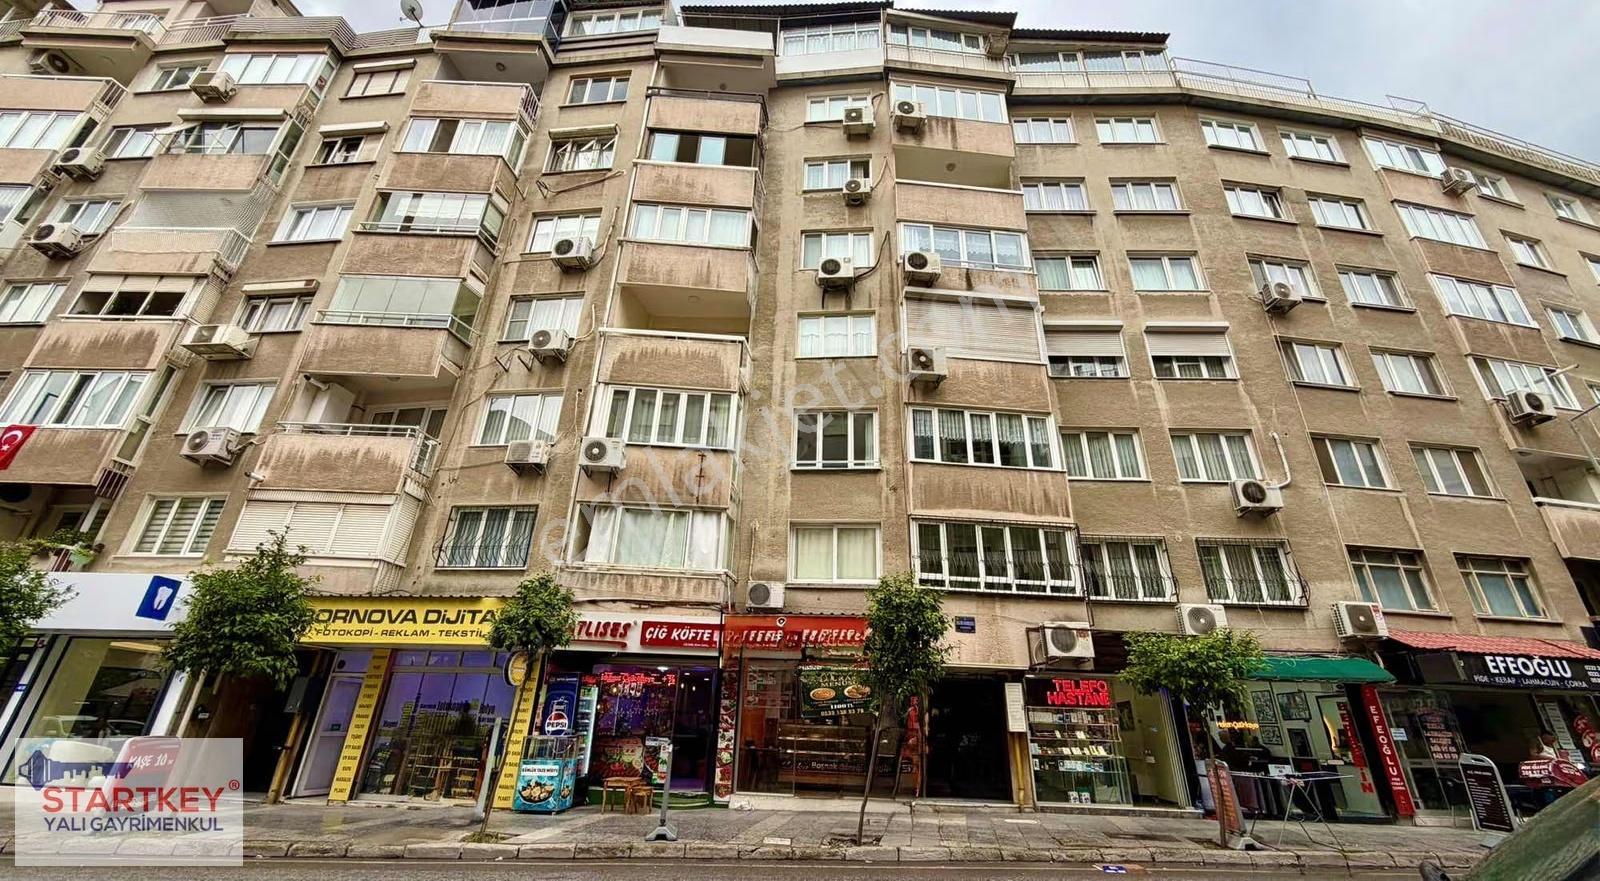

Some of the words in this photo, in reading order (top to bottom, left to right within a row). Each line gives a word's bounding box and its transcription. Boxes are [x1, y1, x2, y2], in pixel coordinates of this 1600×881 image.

[315, 627, 374, 637] FOTOKOPİ
[380, 629, 430, 637] REKLAM
[645, 624, 668, 642] ÇİĞ
[671, 625, 712, 641] KÖFTE
[1484, 655, 1573, 679] EFEOĞLU
[127, 755, 154, 769] KAŞE
[154, 752, 168, 767] 10
